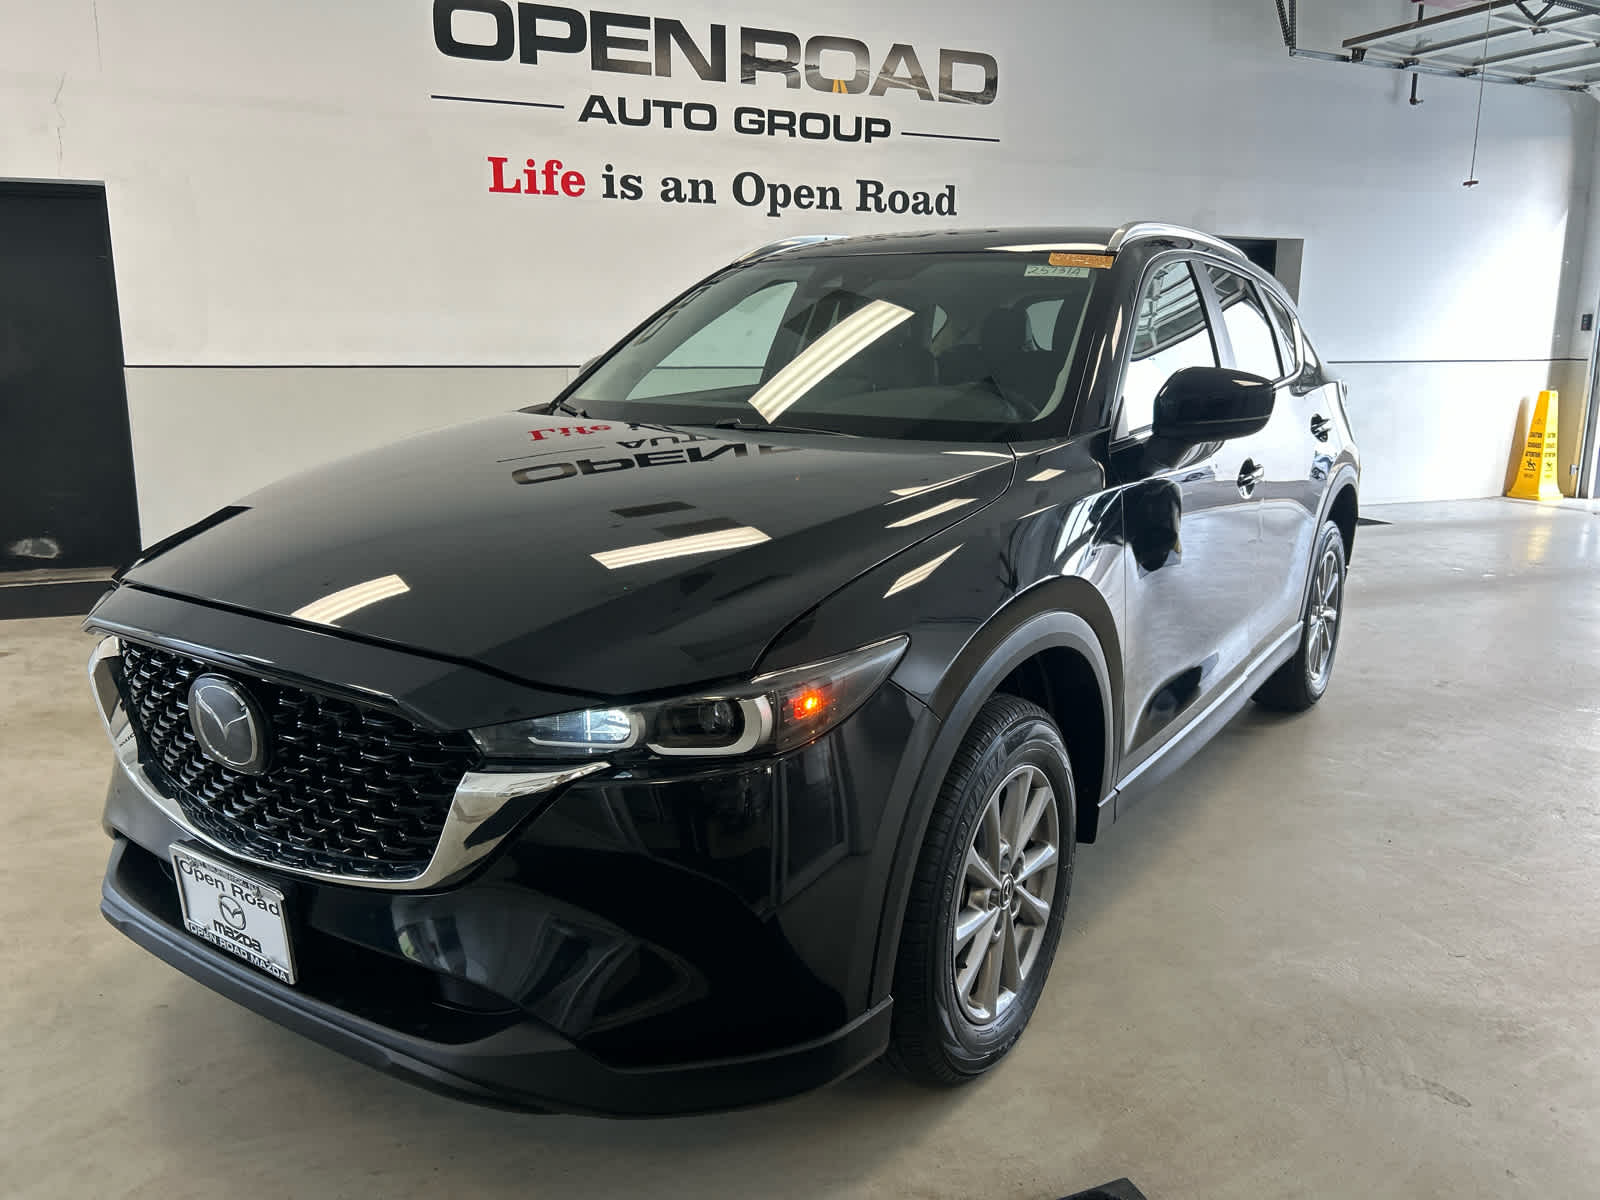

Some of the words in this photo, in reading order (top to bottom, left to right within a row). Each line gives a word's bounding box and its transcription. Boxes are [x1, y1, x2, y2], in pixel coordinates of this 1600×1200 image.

[433, 0, 727, 82] OPEN
[740, 27, 998, 105] ROAD
[578, 95, 717, 132] AUTO
[734, 106, 891, 143] GROUP
[487, 156, 586, 197] Life
[602, 164, 643, 200] is
[661, 176, 716, 205] an
[732, 171, 842, 217] Open
[856, 179, 957, 216] Road
[179, 859, 225, 891] Open
[231, 883, 280, 917] Road
[190, 924, 217, 943] OPEN
[219, 939, 248, 960] ROAD
[250, 954, 288, 983] MAZDA
[213, 919, 263, 953] mazda
